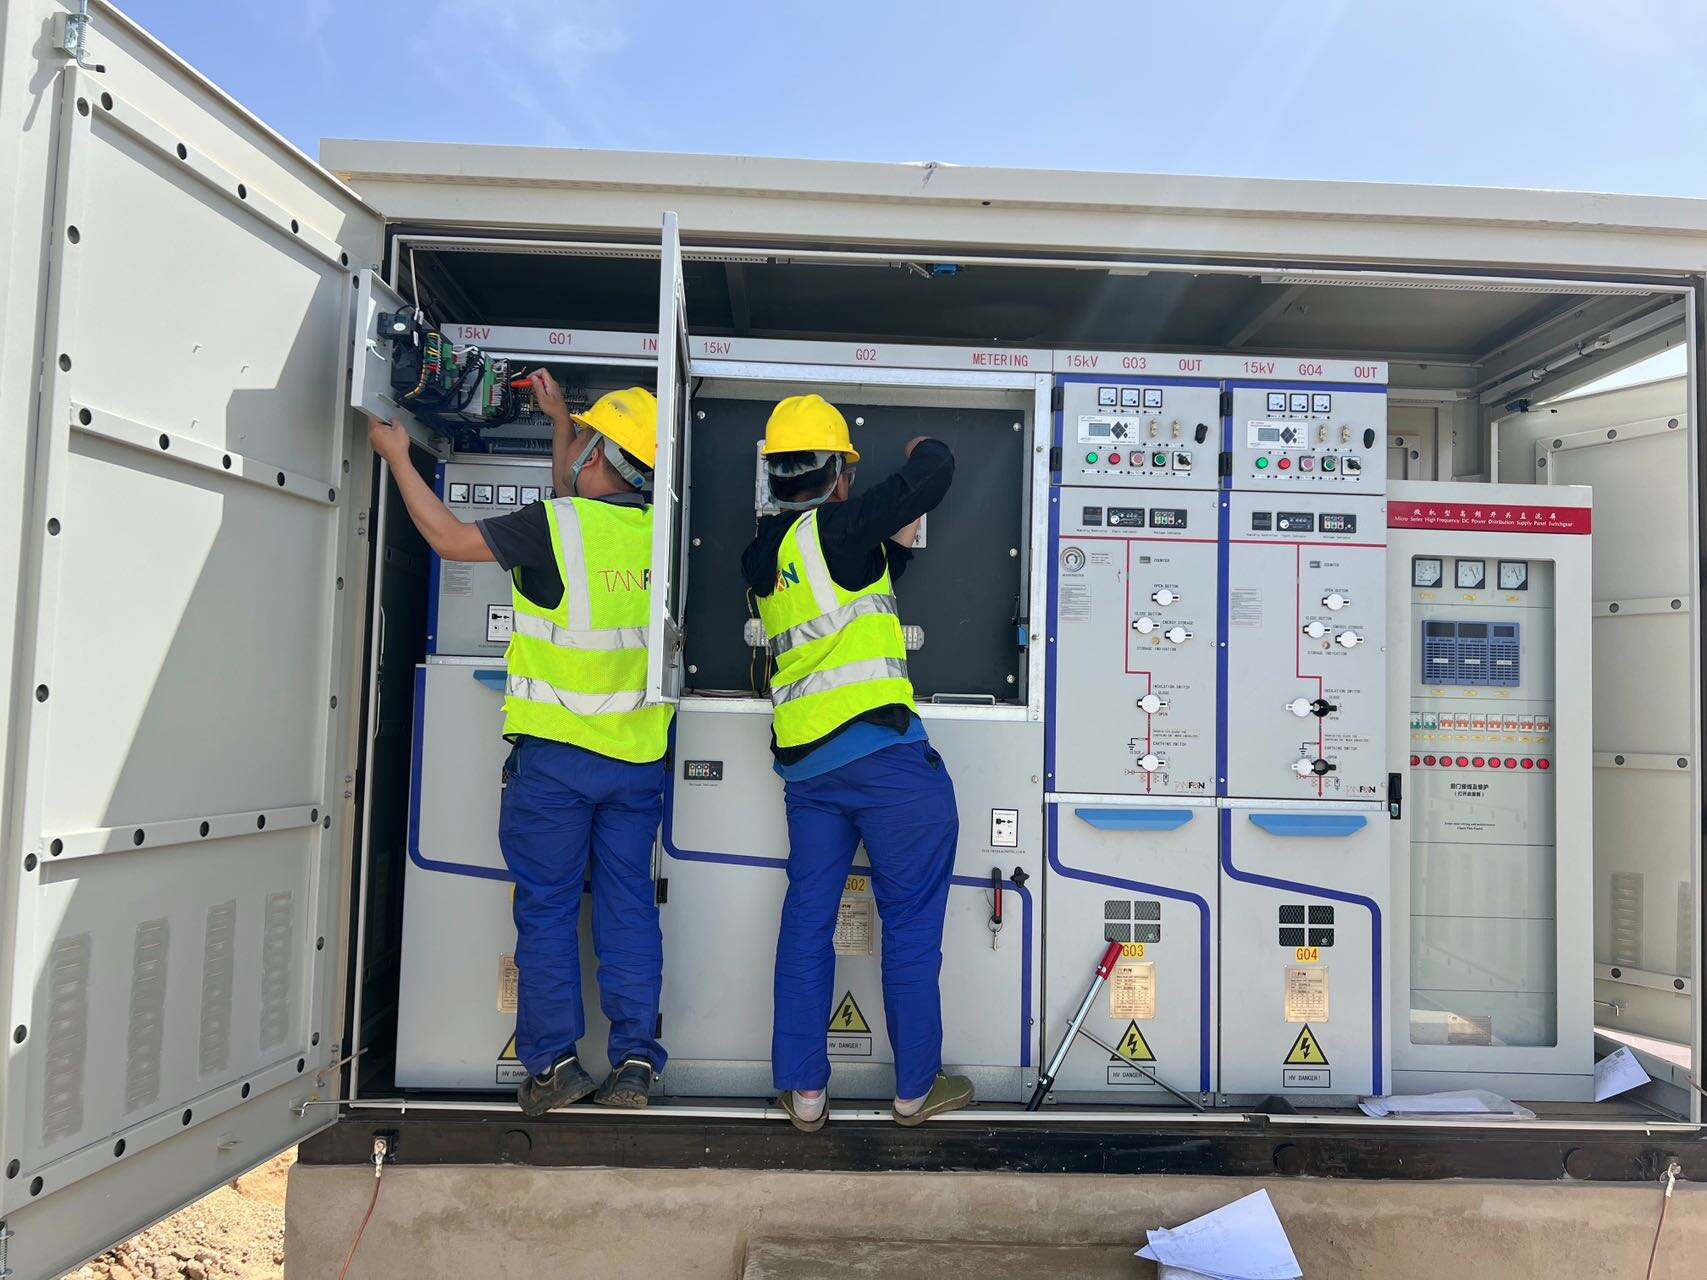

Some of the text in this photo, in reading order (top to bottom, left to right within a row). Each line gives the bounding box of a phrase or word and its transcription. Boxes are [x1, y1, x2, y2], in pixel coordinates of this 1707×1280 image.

[457, 326, 491, 340] 15kV
[703, 341, 731, 354] 15kV
[972, 353, 1028, 367] METERING
[1066, 355, 1099, 368] 15kV
[1178, 359, 1203, 371] OUT
[1243, 361, 1275, 374] 15kV
[1354, 366, 1378, 379] OUT
